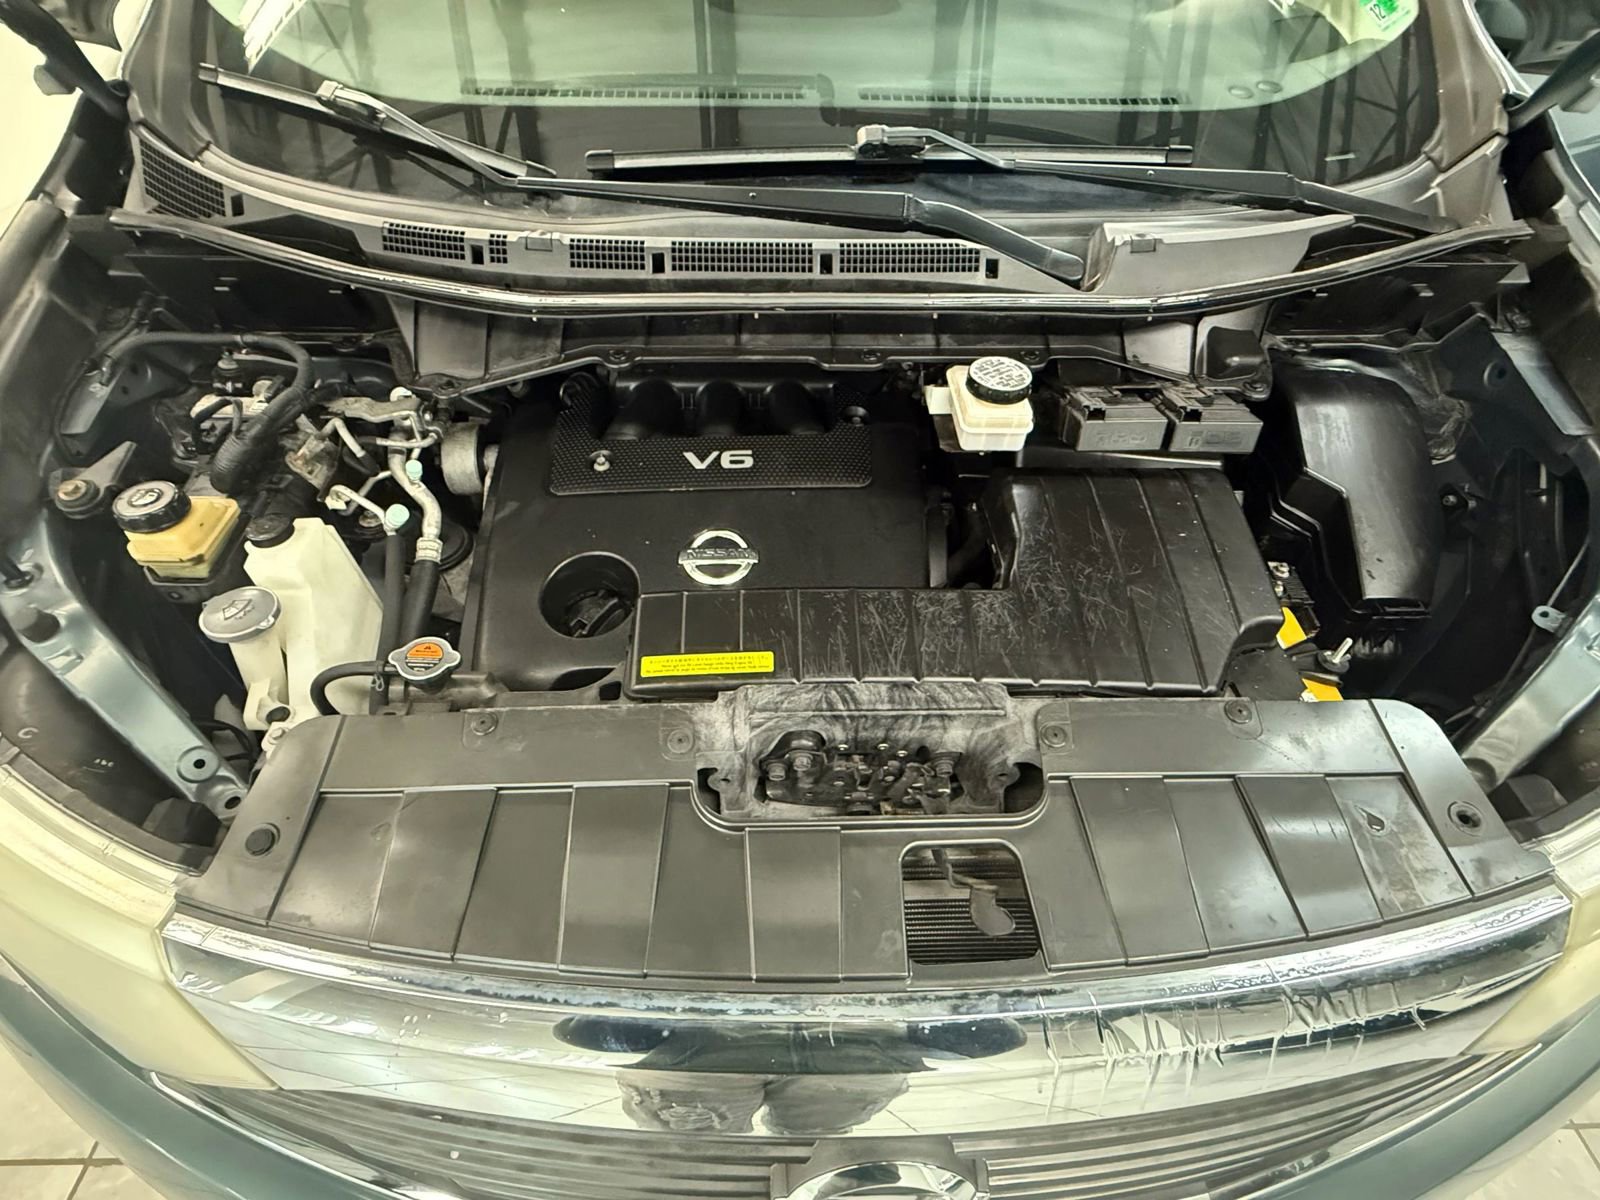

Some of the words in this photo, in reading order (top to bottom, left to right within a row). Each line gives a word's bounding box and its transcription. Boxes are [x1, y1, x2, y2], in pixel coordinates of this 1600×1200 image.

[1370, 3, 1386, 21] 12
[683, 449, 754, 469] V6
[686, 548, 751, 559] NISSAN
